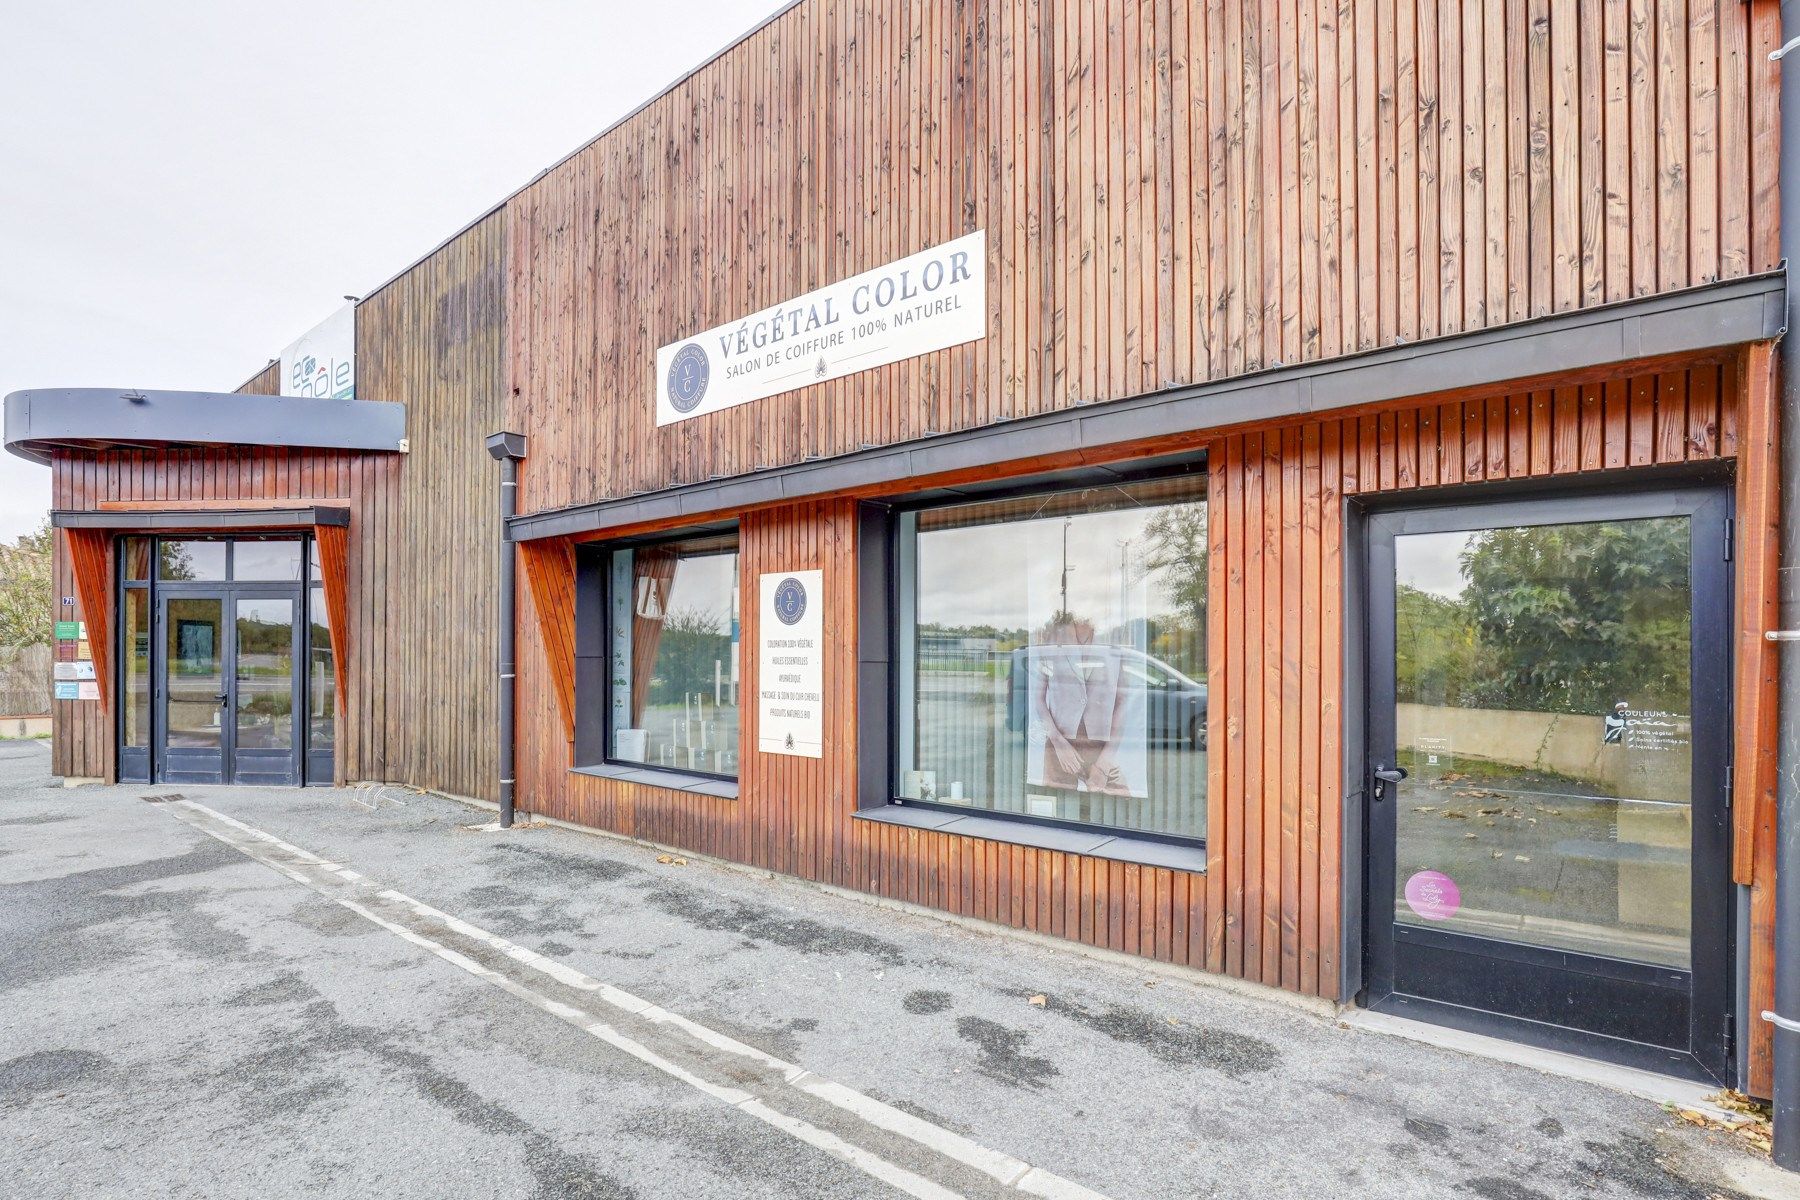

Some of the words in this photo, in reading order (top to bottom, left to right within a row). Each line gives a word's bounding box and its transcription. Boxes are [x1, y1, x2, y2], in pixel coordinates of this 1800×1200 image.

[719, 297, 840, 360] VÉGÉTAL
[851, 250, 972, 316] COLOR
[726, 358, 761, 380] SALON
[766, 352, 781, 368] DE
[785, 330, 844, 362] COIFFURE
[851, 318, 887, 341] 100%
[894, 294, 962, 328] NATUREL
[684, 364, 691, 376] V
[684, 380, 691, 393] C
[786, 591, 793, 600] V
[786, 602, 793, 612] C
[784, 656, 809, 666] ESSENTIELLES
